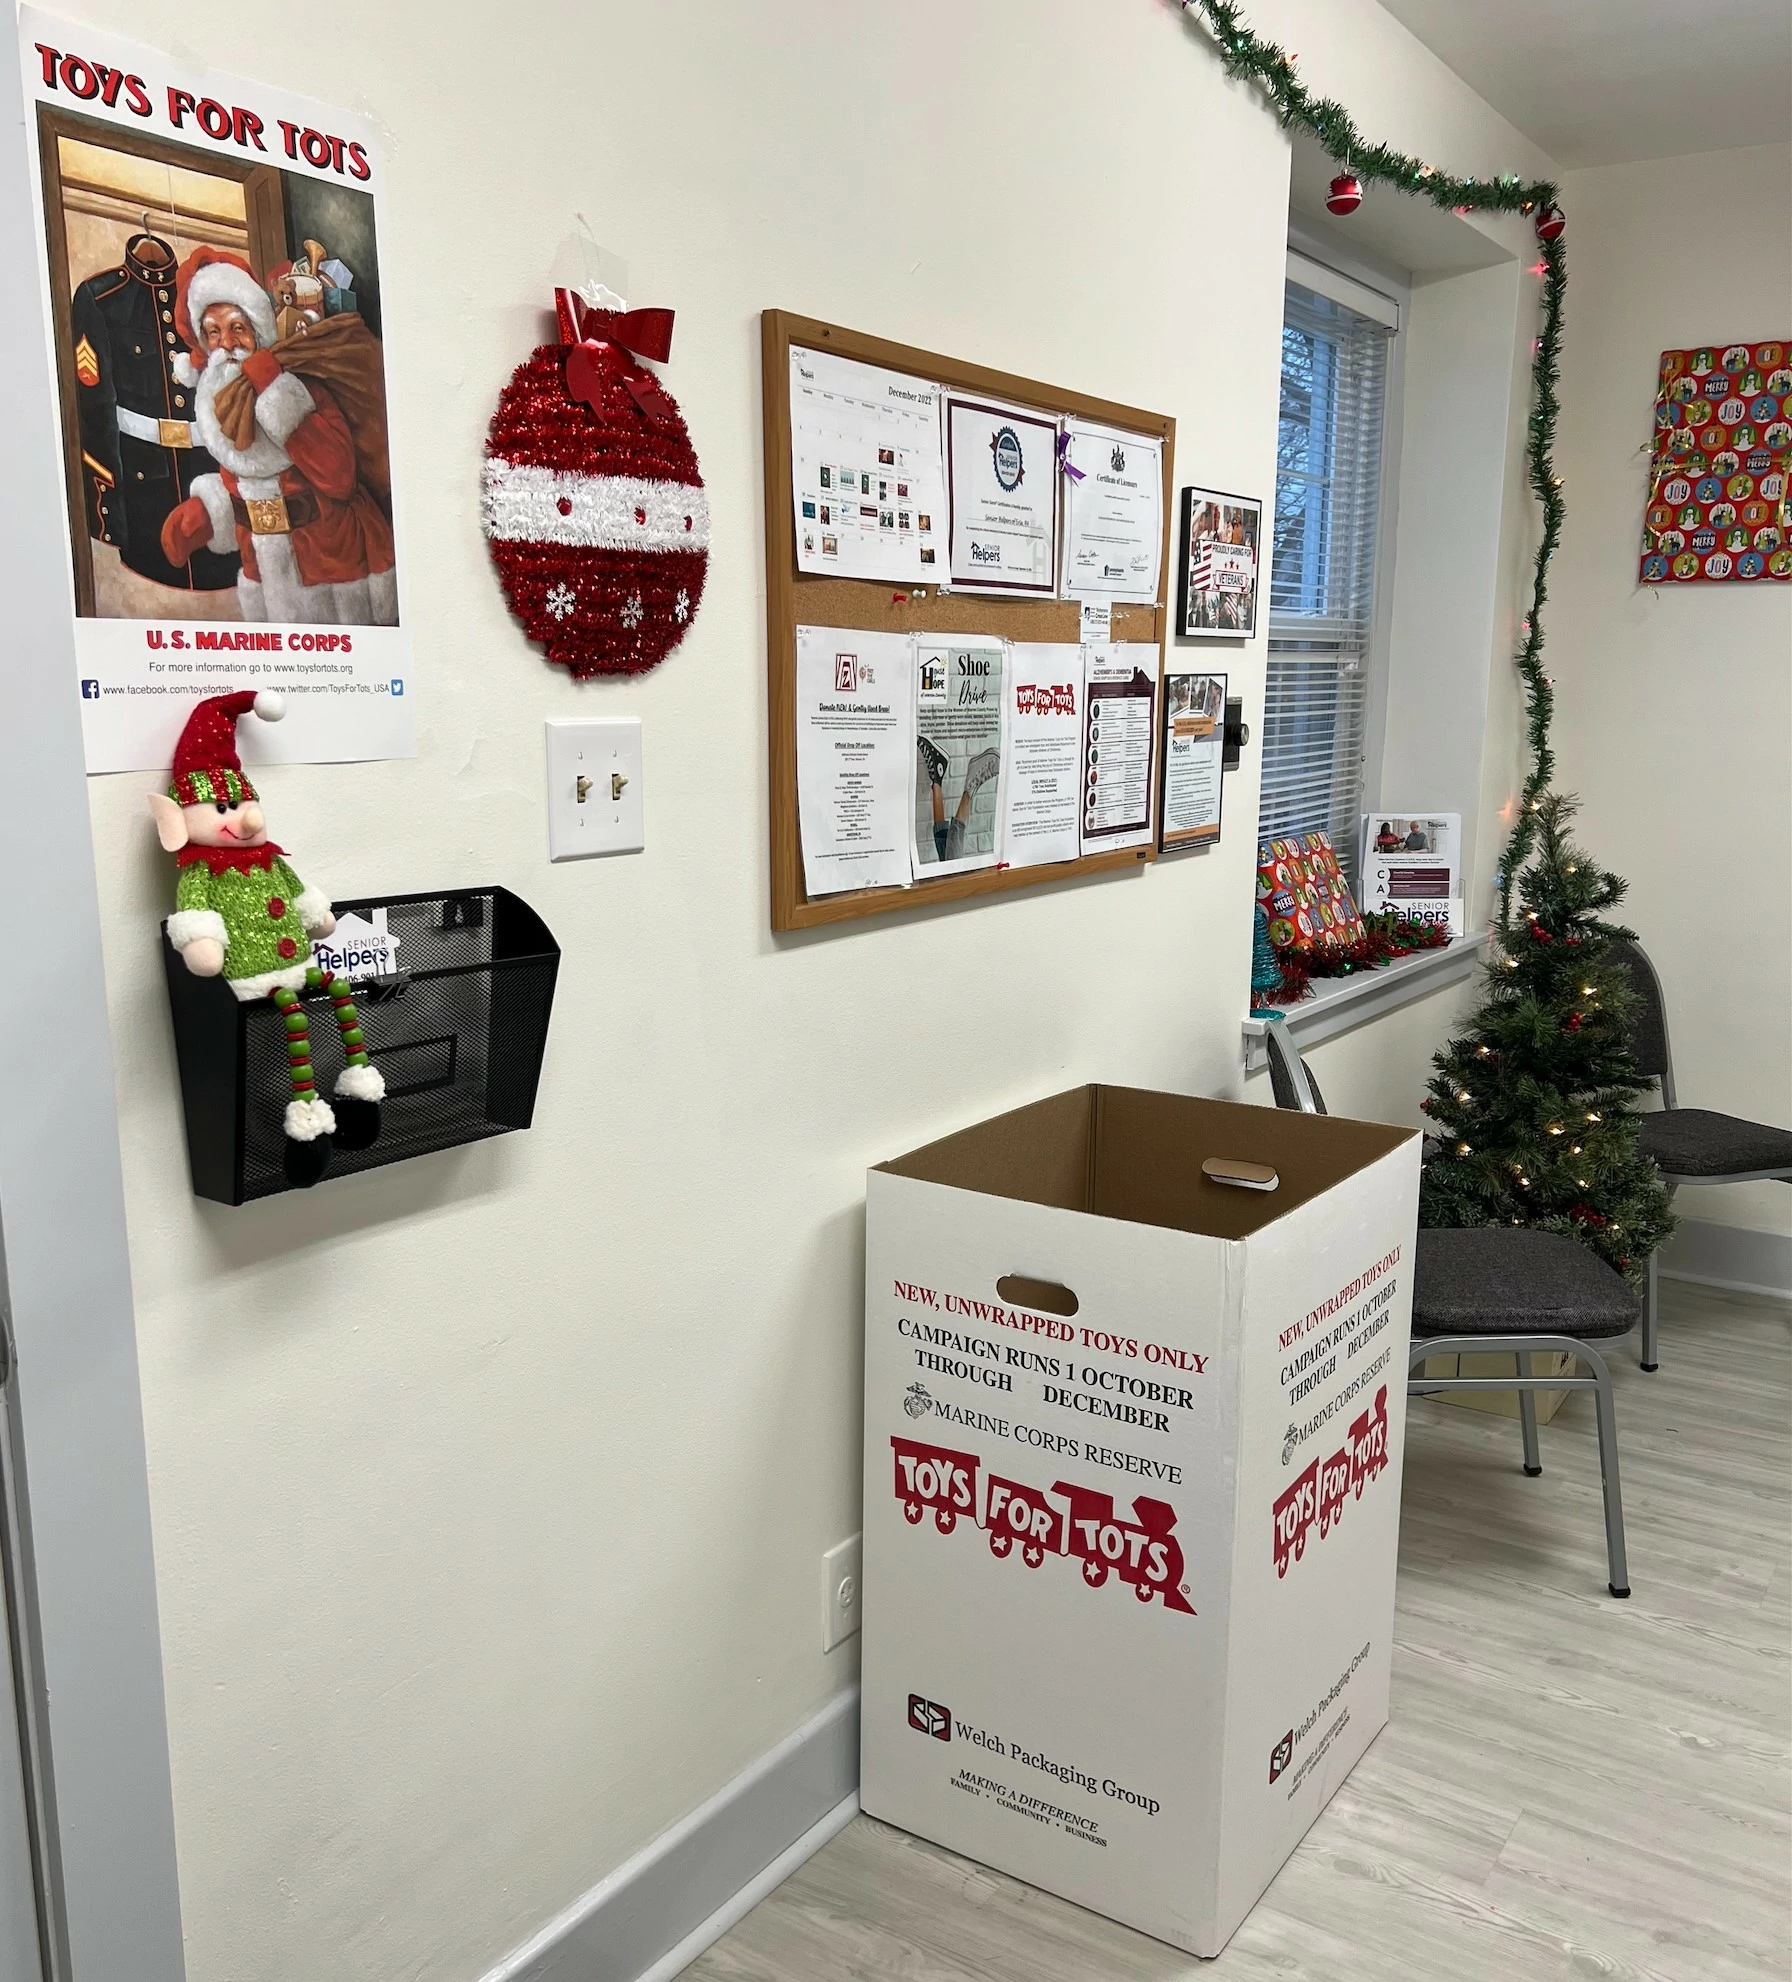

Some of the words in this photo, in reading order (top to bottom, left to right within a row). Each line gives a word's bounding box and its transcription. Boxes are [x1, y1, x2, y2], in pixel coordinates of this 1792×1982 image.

[35, 42, 151, 117] TOYS
[167, 86, 268, 152] FOR
[277, 119, 371, 181] TOTS
[888, 386, 917, 402] December
[918, 394, 932, 405] 2022
[1704, 380, 1729, 393] MERRY
[1721, 403, 1743, 420] JOY
[1667, 483, 1687, 499] JOY
[1212, 543, 1229, 555] PROUDLY
[1230, 546, 1243, 556] CARING
[1244, 548, 1252, 557] FOR
[1692, 535, 1715, 547] MERRY
[972, 548, 1000, 563] Helpers
[1708, 562, 1729, 574] JOY
[1218, 573, 1244, 586] VETERANS
[146, 630, 168, 650] U.
[172, 631, 191, 650] S.
[195, 631, 283, 651] MARINE
[288, 633, 353, 653] CORPS
[149, 661, 166, 673] For
[168, 664, 193, 673] more
[195, 661, 247, 673] information
[249, 664, 261, 676] go
[263, 663, 272, 673] to
[274, 663, 353, 675] www.toysfortots.org
[958, 654, 990, 676] Shoe
[103, 684, 234, 696] www.facebook.com/toysfortots
[958, 679, 988, 706] Drive
[1018, 689, 1034, 705] TOYS
[1038, 692, 1051, 707] FOR
[1055, 694, 1072, 708] TOTS
[819, 703, 835, 711] Donate
[1377, 870, 1385, 879] C
[1376, 884, 1385, 894] A
[1385, 907, 1449, 922] elpers
[1412, 902, 1449, 910] SENIOR
[347, 936, 387, 950] SENIOR
[1279, 1319, 1304, 1352] NEW,
[1306, 1278, 1360, 1332] UNWRAPPED
[1362, 1261, 1382, 1290] TOYS
[1383, 1244, 1401, 1273] ONLY
[894, 1280, 940, 1311] NEW,
[944, 1294, 1074, 1342] UNWRAPPED
[1080, 1328, 1138, 1358] TOYS
[1143, 1343, 1209, 1374] ONLY
[1280, 1333, 1332, 1386] CAMPAIGN
[1333, 1314, 1356, 1347] RUNS
[1356, 1310, 1361, 1327] 1
[1362, 1279, 1397, 1322] OCTOBER
[898, 1318, 1000, 1361] CAMPAIGN
[1005, 1346, 1060, 1377] RUNS
[1066, 1363, 1074, 1380] 1
[1082, 1367, 1194, 1410] OCTOBER
[1289, 1355, 1336, 1406] THROUGH
[1347, 1309, 1389, 1360] DECEMBER
[915, 1349, 1013, 1392] THROUGH
[1043, 1384, 1170, 1433] DECEMBER
[1298, 1404, 1334, 1446] MARINE
[1334, 1380, 1360, 1412] CORPS
[1361, 1347, 1391, 1390] RESERVE
[934, 1400, 1010, 1438] MARINE
[1014, 1425, 1079, 1457] CORPS
[1084, 1444, 1182, 1485] RESERVE
[1277, 1480, 1313, 1545] TOYS
[1321, 1463, 1347, 1505] FOR
[1354, 1420, 1384, 1464] TOTS
[898, 1455, 969, 1507] TOYS
[990, 1485, 1053, 1543] FOR
[1075, 1519, 1168, 1582] TOTS
[955, 1721, 1006, 1756] Welch
[1010, 1743, 1098, 1795] Packaging
[1102, 1779, 1161, 1817] Group
[958, 1769, 1007, 1796] MAKING
[1009, 1790, 1016, 1801] A
[1019, 1794, 1099, 1833] DIFFERENCE
[950, 1777, 981, 1797] FAMILY
[996, 1798, 1051, 1825] COMMUNITY
[1065, 1825, 1107, 1848] BUSINESS
